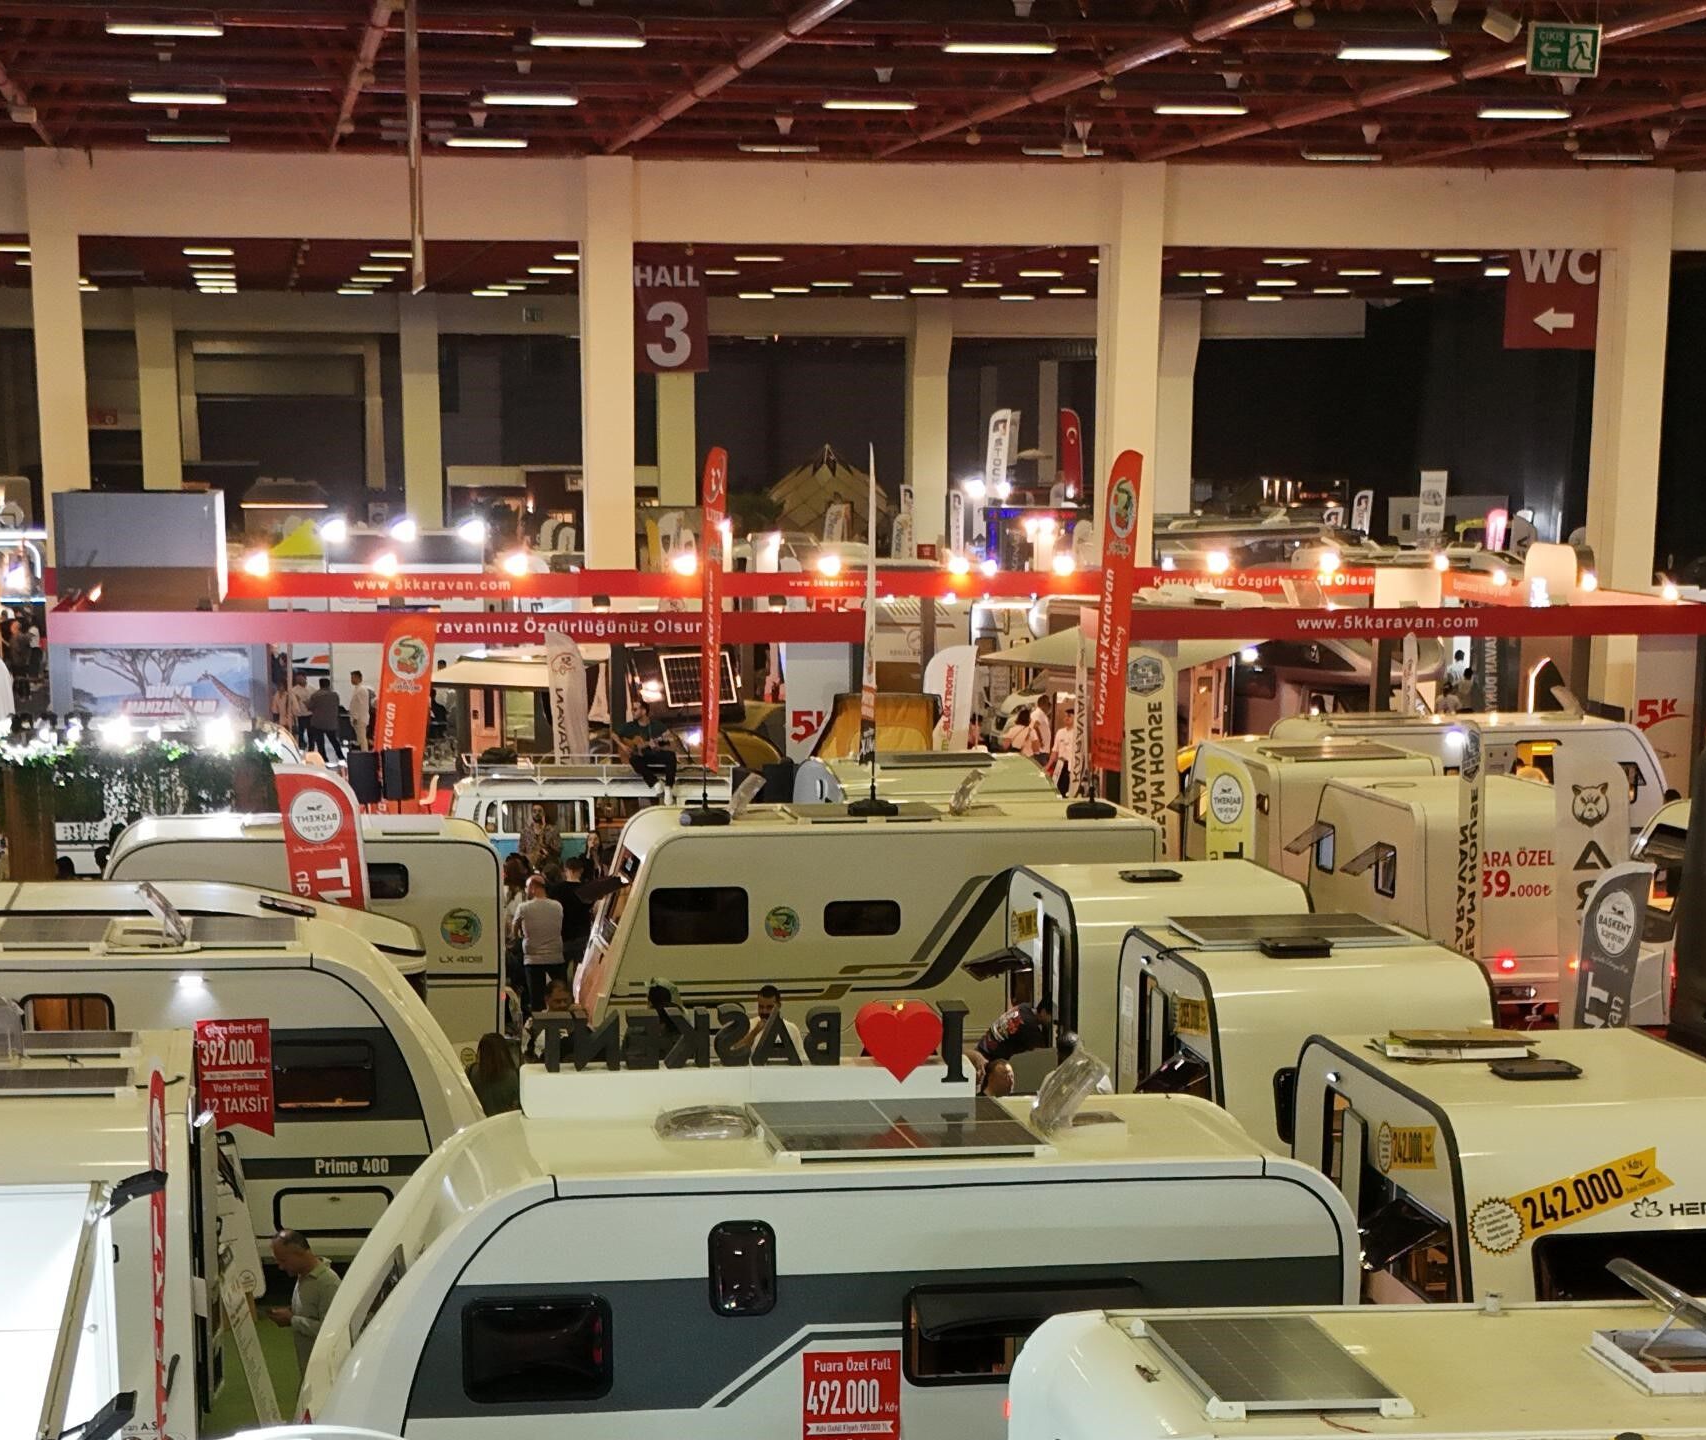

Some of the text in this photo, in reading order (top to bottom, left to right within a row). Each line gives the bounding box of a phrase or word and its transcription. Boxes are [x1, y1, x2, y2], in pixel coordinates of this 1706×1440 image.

[634, 263, 700, 288] HALL
[1518, 249, 1598, 285] WC
[646, 300, 692, 367] 3
[435, 621, 519, 634] ravanınız
[1296, 615, 1479, 630] www.5kkaravan.com
[1516, 847, 1555, 867] ÖZEL
[200, 1039, 255, 1067] 392.000
[224, 1095, 270, 1113] TAKSİT
[315, 1157, 390, 1175] Prime 400
[1521, 1167, 1626, 1230] 242.000
[814, 1356, 892, 1373] Fuara Özel Full
[805, 1378, 880, 1416] 492.000
